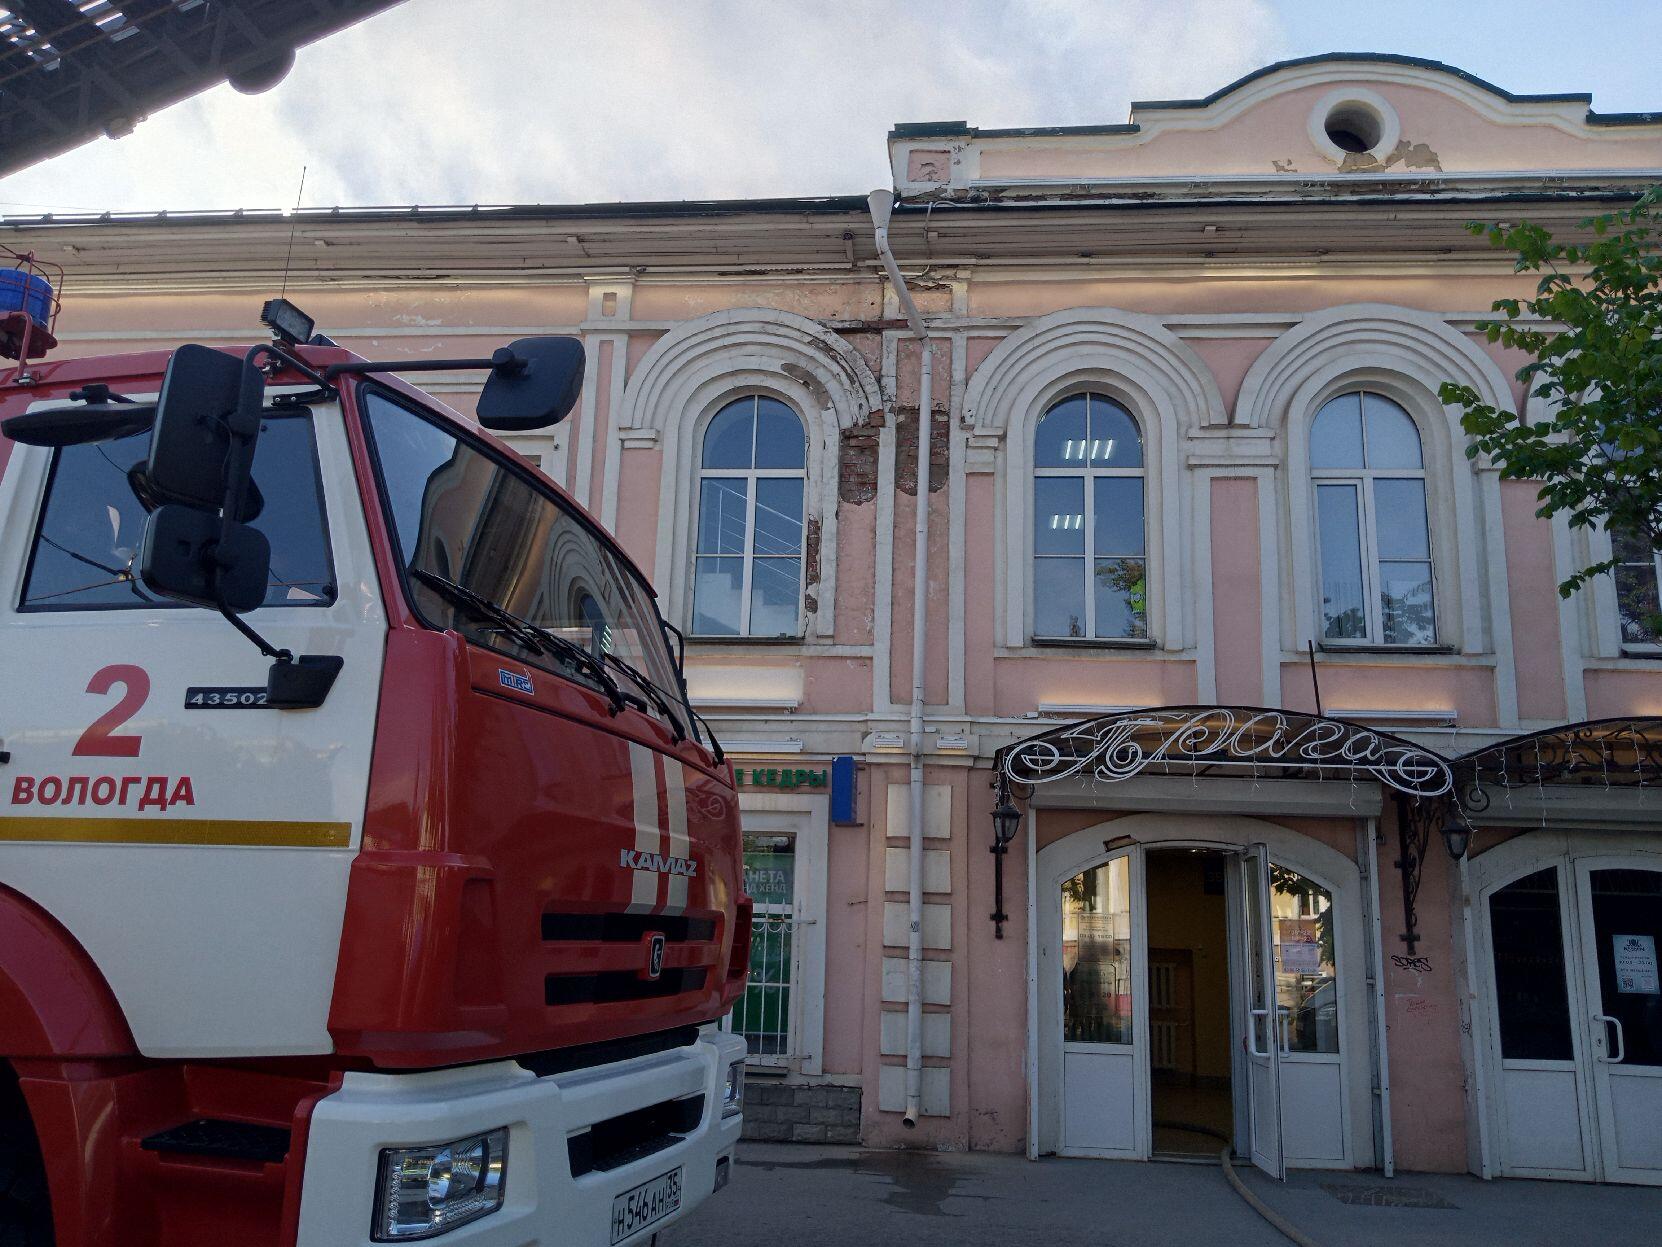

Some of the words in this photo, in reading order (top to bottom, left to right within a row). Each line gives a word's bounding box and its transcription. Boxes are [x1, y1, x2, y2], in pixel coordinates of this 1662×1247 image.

[72, 664, 150, 757] 2
[191, 692, 267, 705] 43502
[752, 768, 827, 788] КЕДРЫ
[11, 776, 195, 811] ВОЛОГДА
[620, 848, 697, 877] KAMAZ
[668, 1172, 678, 1198] 35
